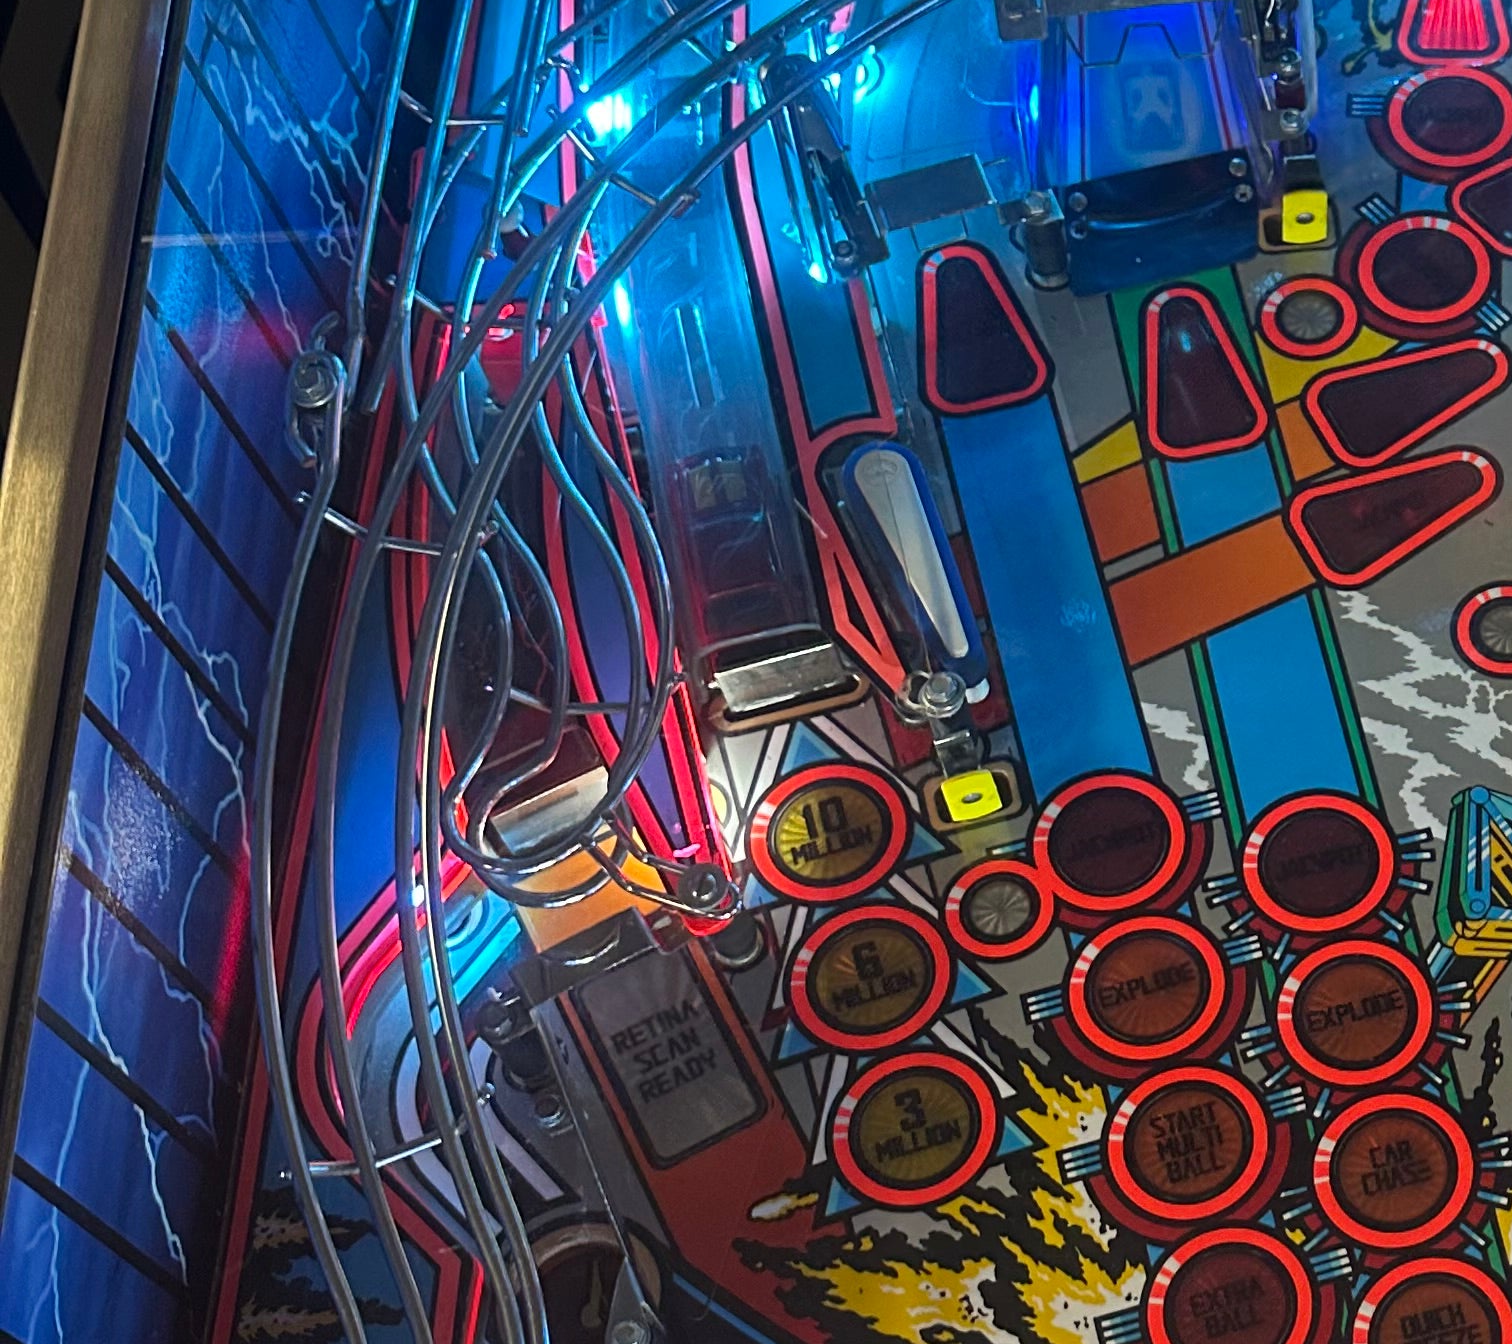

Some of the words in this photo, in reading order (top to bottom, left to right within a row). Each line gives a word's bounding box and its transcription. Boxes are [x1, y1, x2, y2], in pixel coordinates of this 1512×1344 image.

[800, 795, 847, 839] 10
[790, 828, 874, 867] MILLION
[852, 940, 884, 981] 6
[831, 972, 917, 1014] MILLION
[1099, 962, 1197, 1009] EXPLODE
[612, 1001, 701, 1054] RETINA
[1306, 986, 1407, 1034] EXPLODE
[636, 1032, 704, 1074] SCAN
[639, 1054, 720, 1103] READY
[894, 1088, 927, 1127] 3
[1149, 1101, 1217, 1139] START
[875, 1122, 962, 1162] MILLION
[1156, 1126, 1224, 1159] MULTI
[1368, 1140, 1412, 1169] CAR
[1167, 1153, 1226, 1184] BALL
[1361, 1158, 1433, 1197] CHASE
[1189, 1277, 1265, 1313] EXTRA
[1203, 1308, 1265, 1338] BALL
[1398, 1303, 1468, 1340] QUICK
